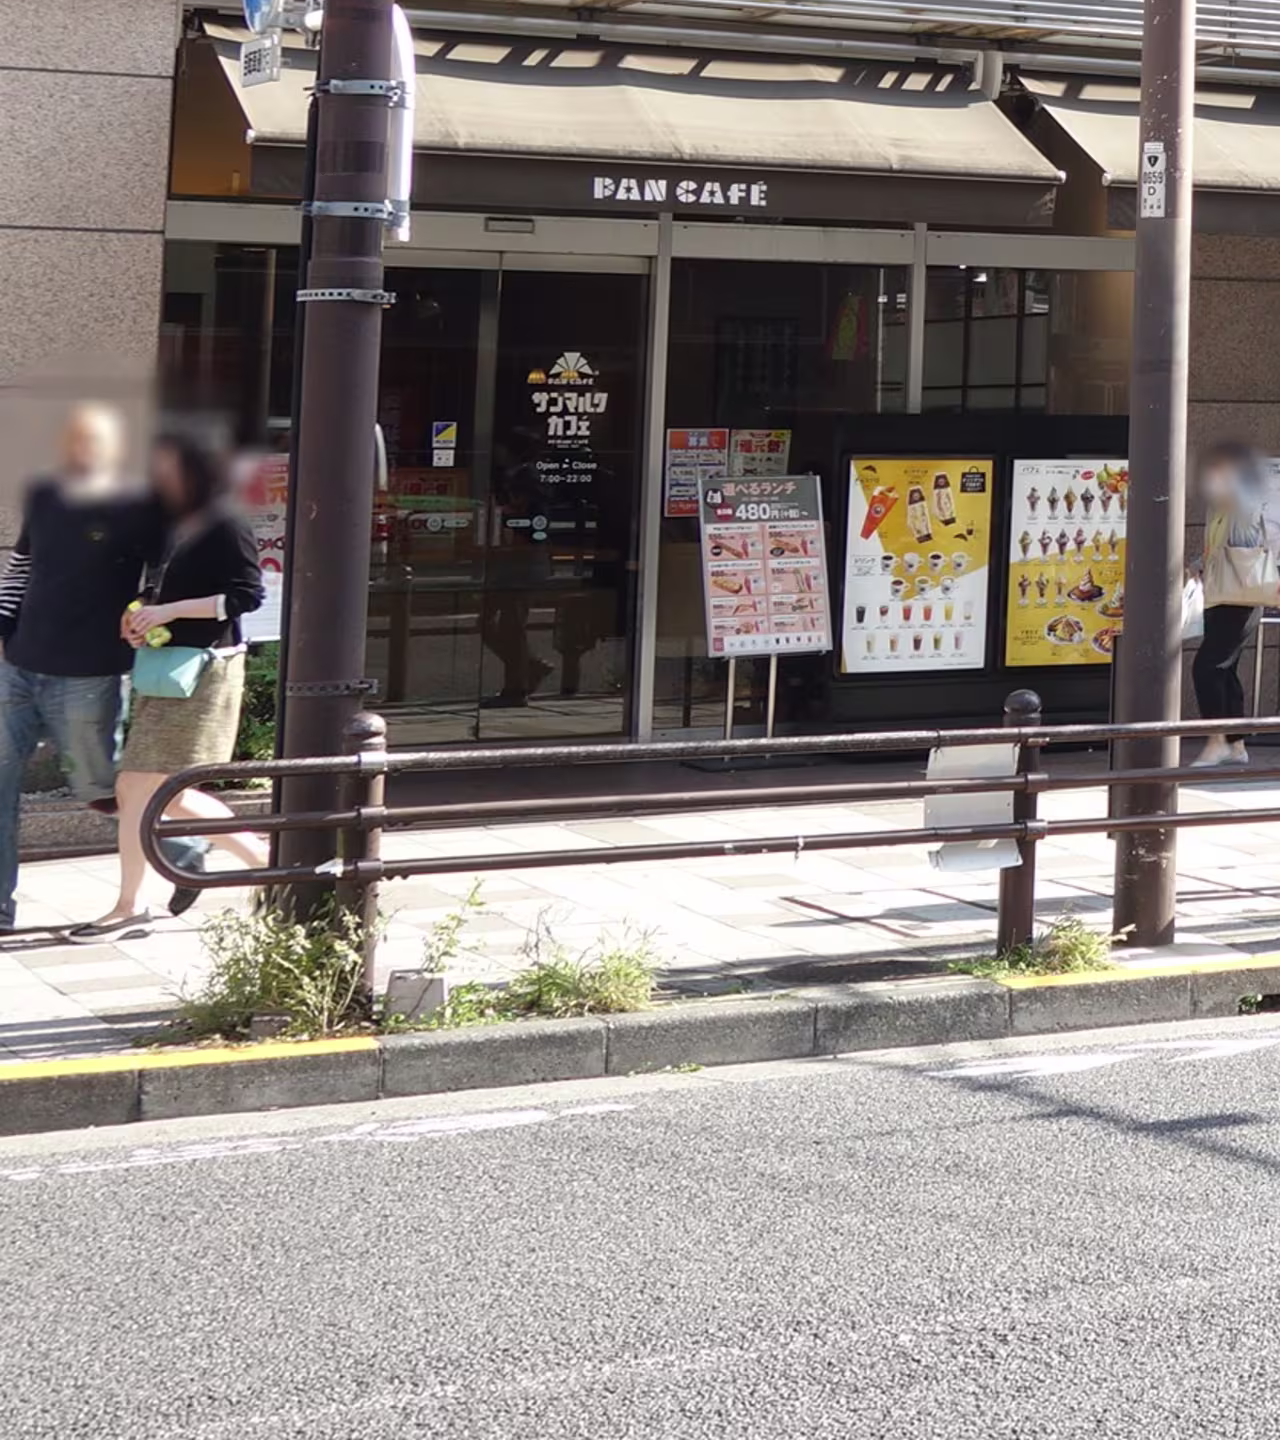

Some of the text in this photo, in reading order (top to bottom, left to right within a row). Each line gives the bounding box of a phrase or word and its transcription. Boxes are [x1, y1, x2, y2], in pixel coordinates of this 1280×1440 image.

[593, 176, 667, 202] PAN
[531, 391, 609, 413] サンマルク
[547, 415, 591, 436] カフェ
[536, 461, 598, 471] Open Close
[722, 481, 797, 496] 選べるランチ
